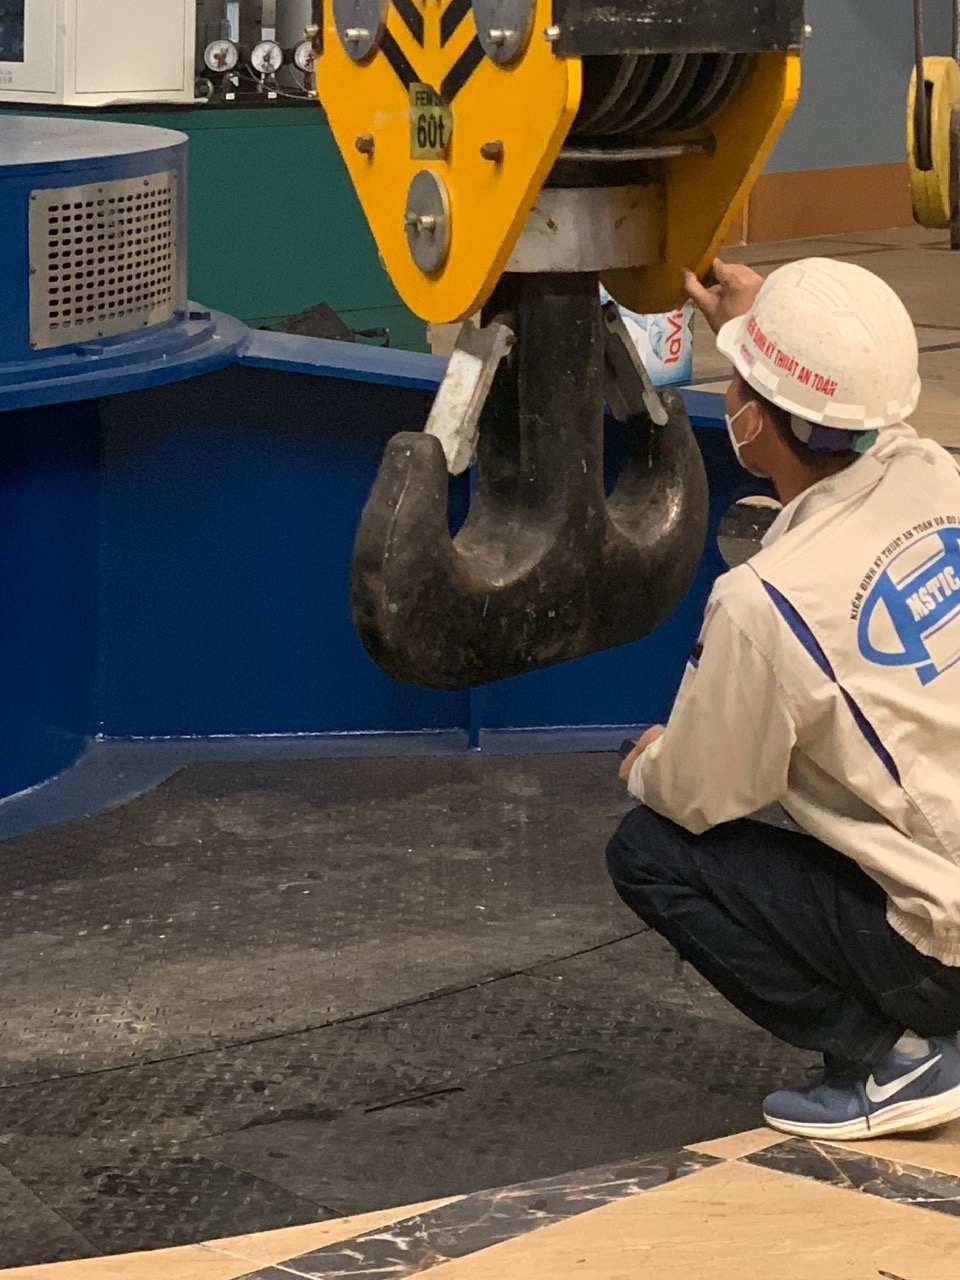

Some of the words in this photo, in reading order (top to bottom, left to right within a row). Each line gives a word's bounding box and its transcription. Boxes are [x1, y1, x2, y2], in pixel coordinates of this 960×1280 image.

[417, 113, 445, 148] 60t
[774, 349, 799, 377] THUẬT
[797, 366, 812, 386] AN
[902, 531, 914, 542] AN
